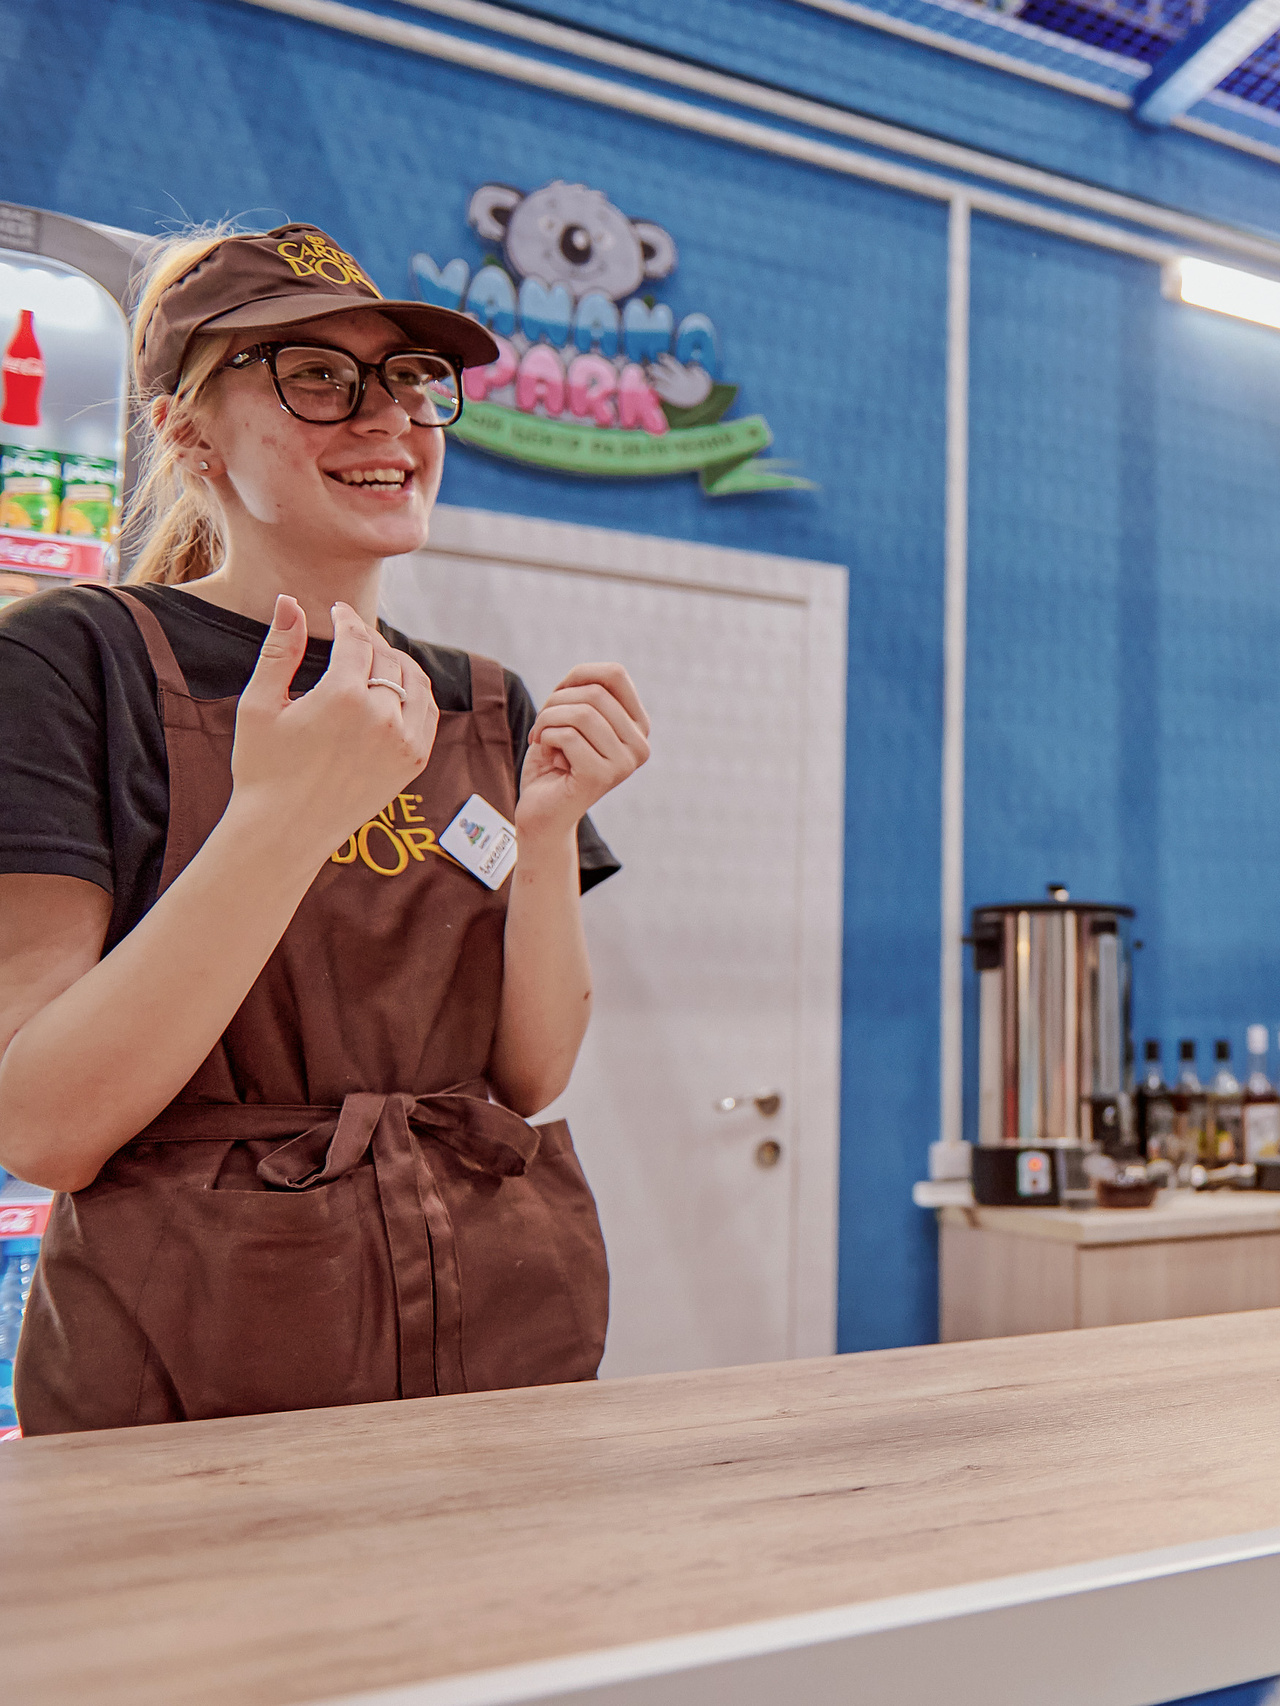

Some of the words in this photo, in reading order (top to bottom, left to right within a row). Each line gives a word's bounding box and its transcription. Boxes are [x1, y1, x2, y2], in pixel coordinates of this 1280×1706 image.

[277, 242, 356, 268] CARTE
[285, 257, 381, 299] D'OR
[462, 331, 670, 436] PARK
